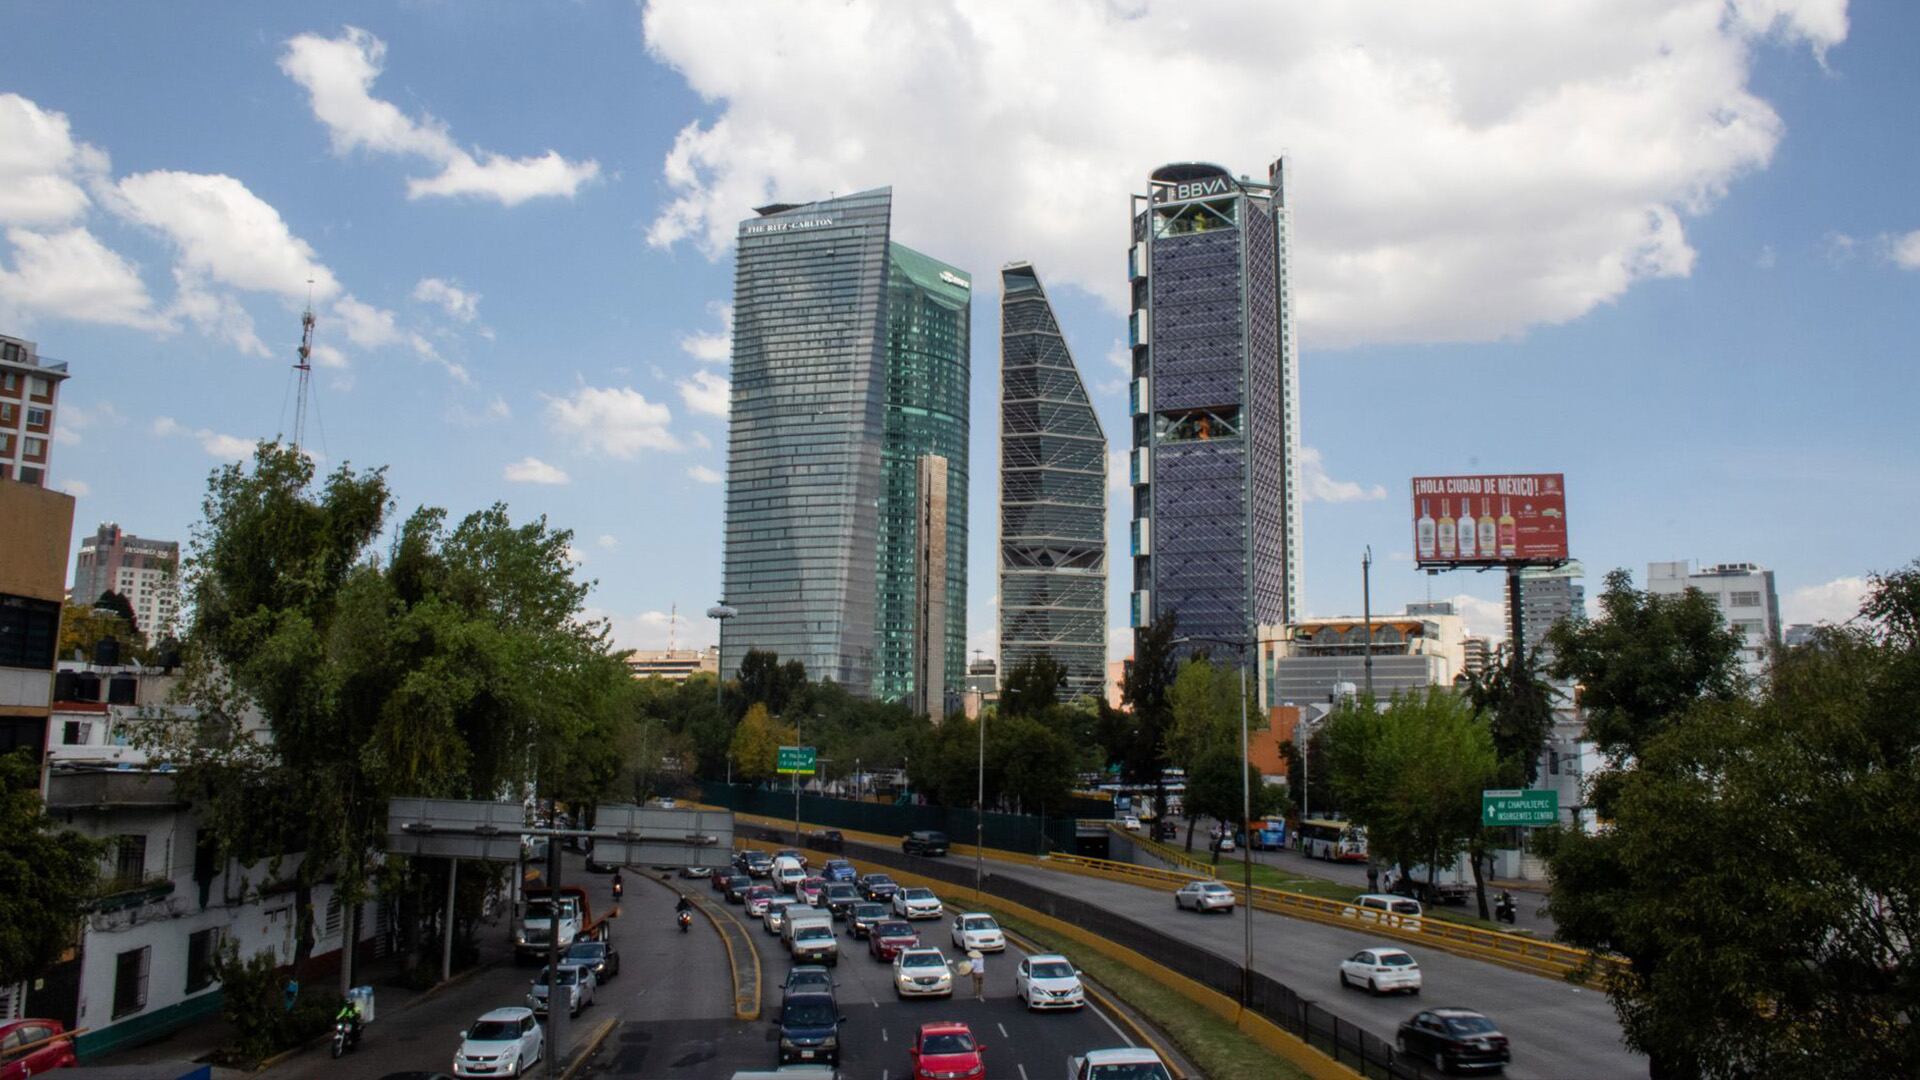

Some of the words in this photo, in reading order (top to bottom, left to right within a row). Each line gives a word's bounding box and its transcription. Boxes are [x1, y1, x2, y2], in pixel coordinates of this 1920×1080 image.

[1178, 178, 1227, 199] BBVA
[748, 224, 765, 233] THE
[1415, 479, 1444, 495] ¡HOLA
[1447, 478, 1481, 494] CIUDAD
[1484, 478, 1496, 494] DE
[1508, 800, 1549, 809] CHAPULTEPEC
[1498, 812, 1532, 820] INSURGENTES
